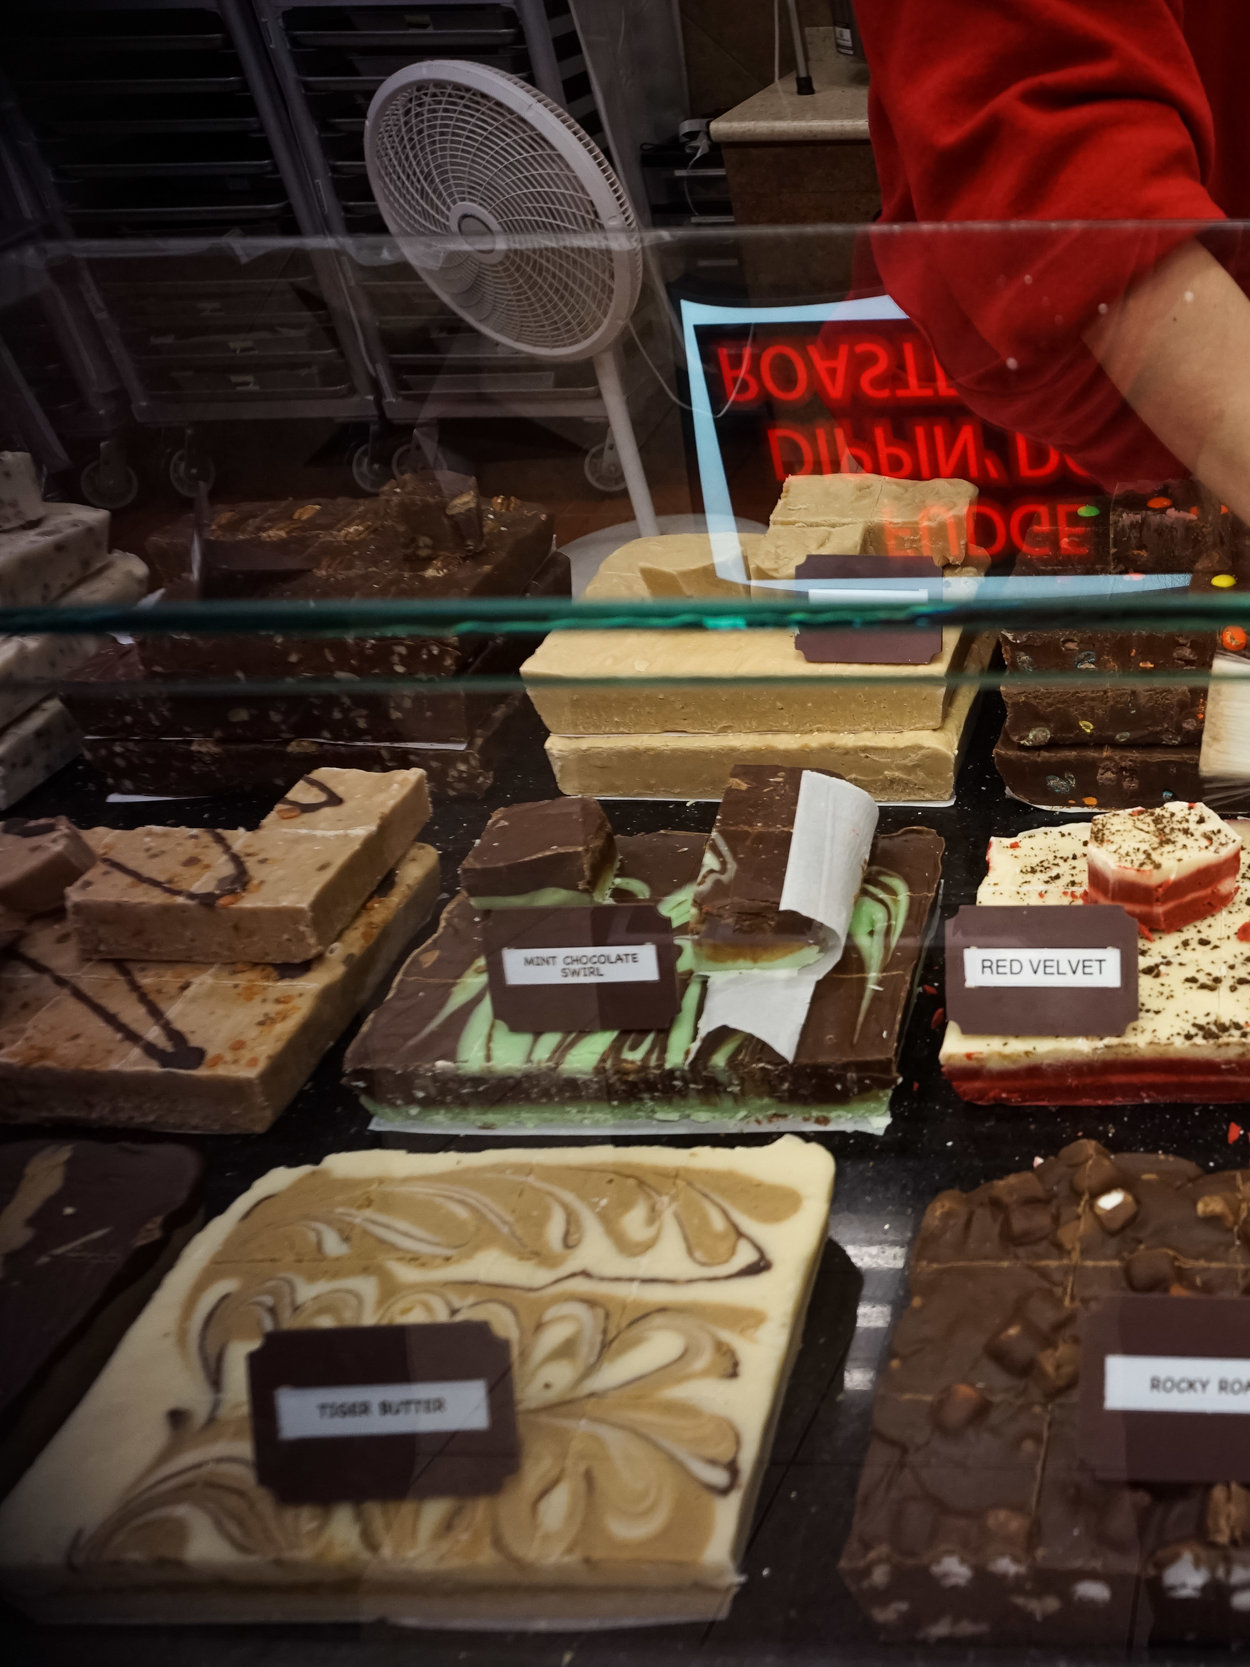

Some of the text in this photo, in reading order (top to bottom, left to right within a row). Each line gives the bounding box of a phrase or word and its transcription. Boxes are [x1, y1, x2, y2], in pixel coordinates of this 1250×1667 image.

[523, 953, 639, 967] MINT CHOCOLATE
[981, 959, 1106, 975] RED VELVET
[560, 966, 604, 978] SWIRL
[1149, 1375, 1210, 1394] ROCKY
[316, 1396, 446, 1418] TIGER BUTTER
